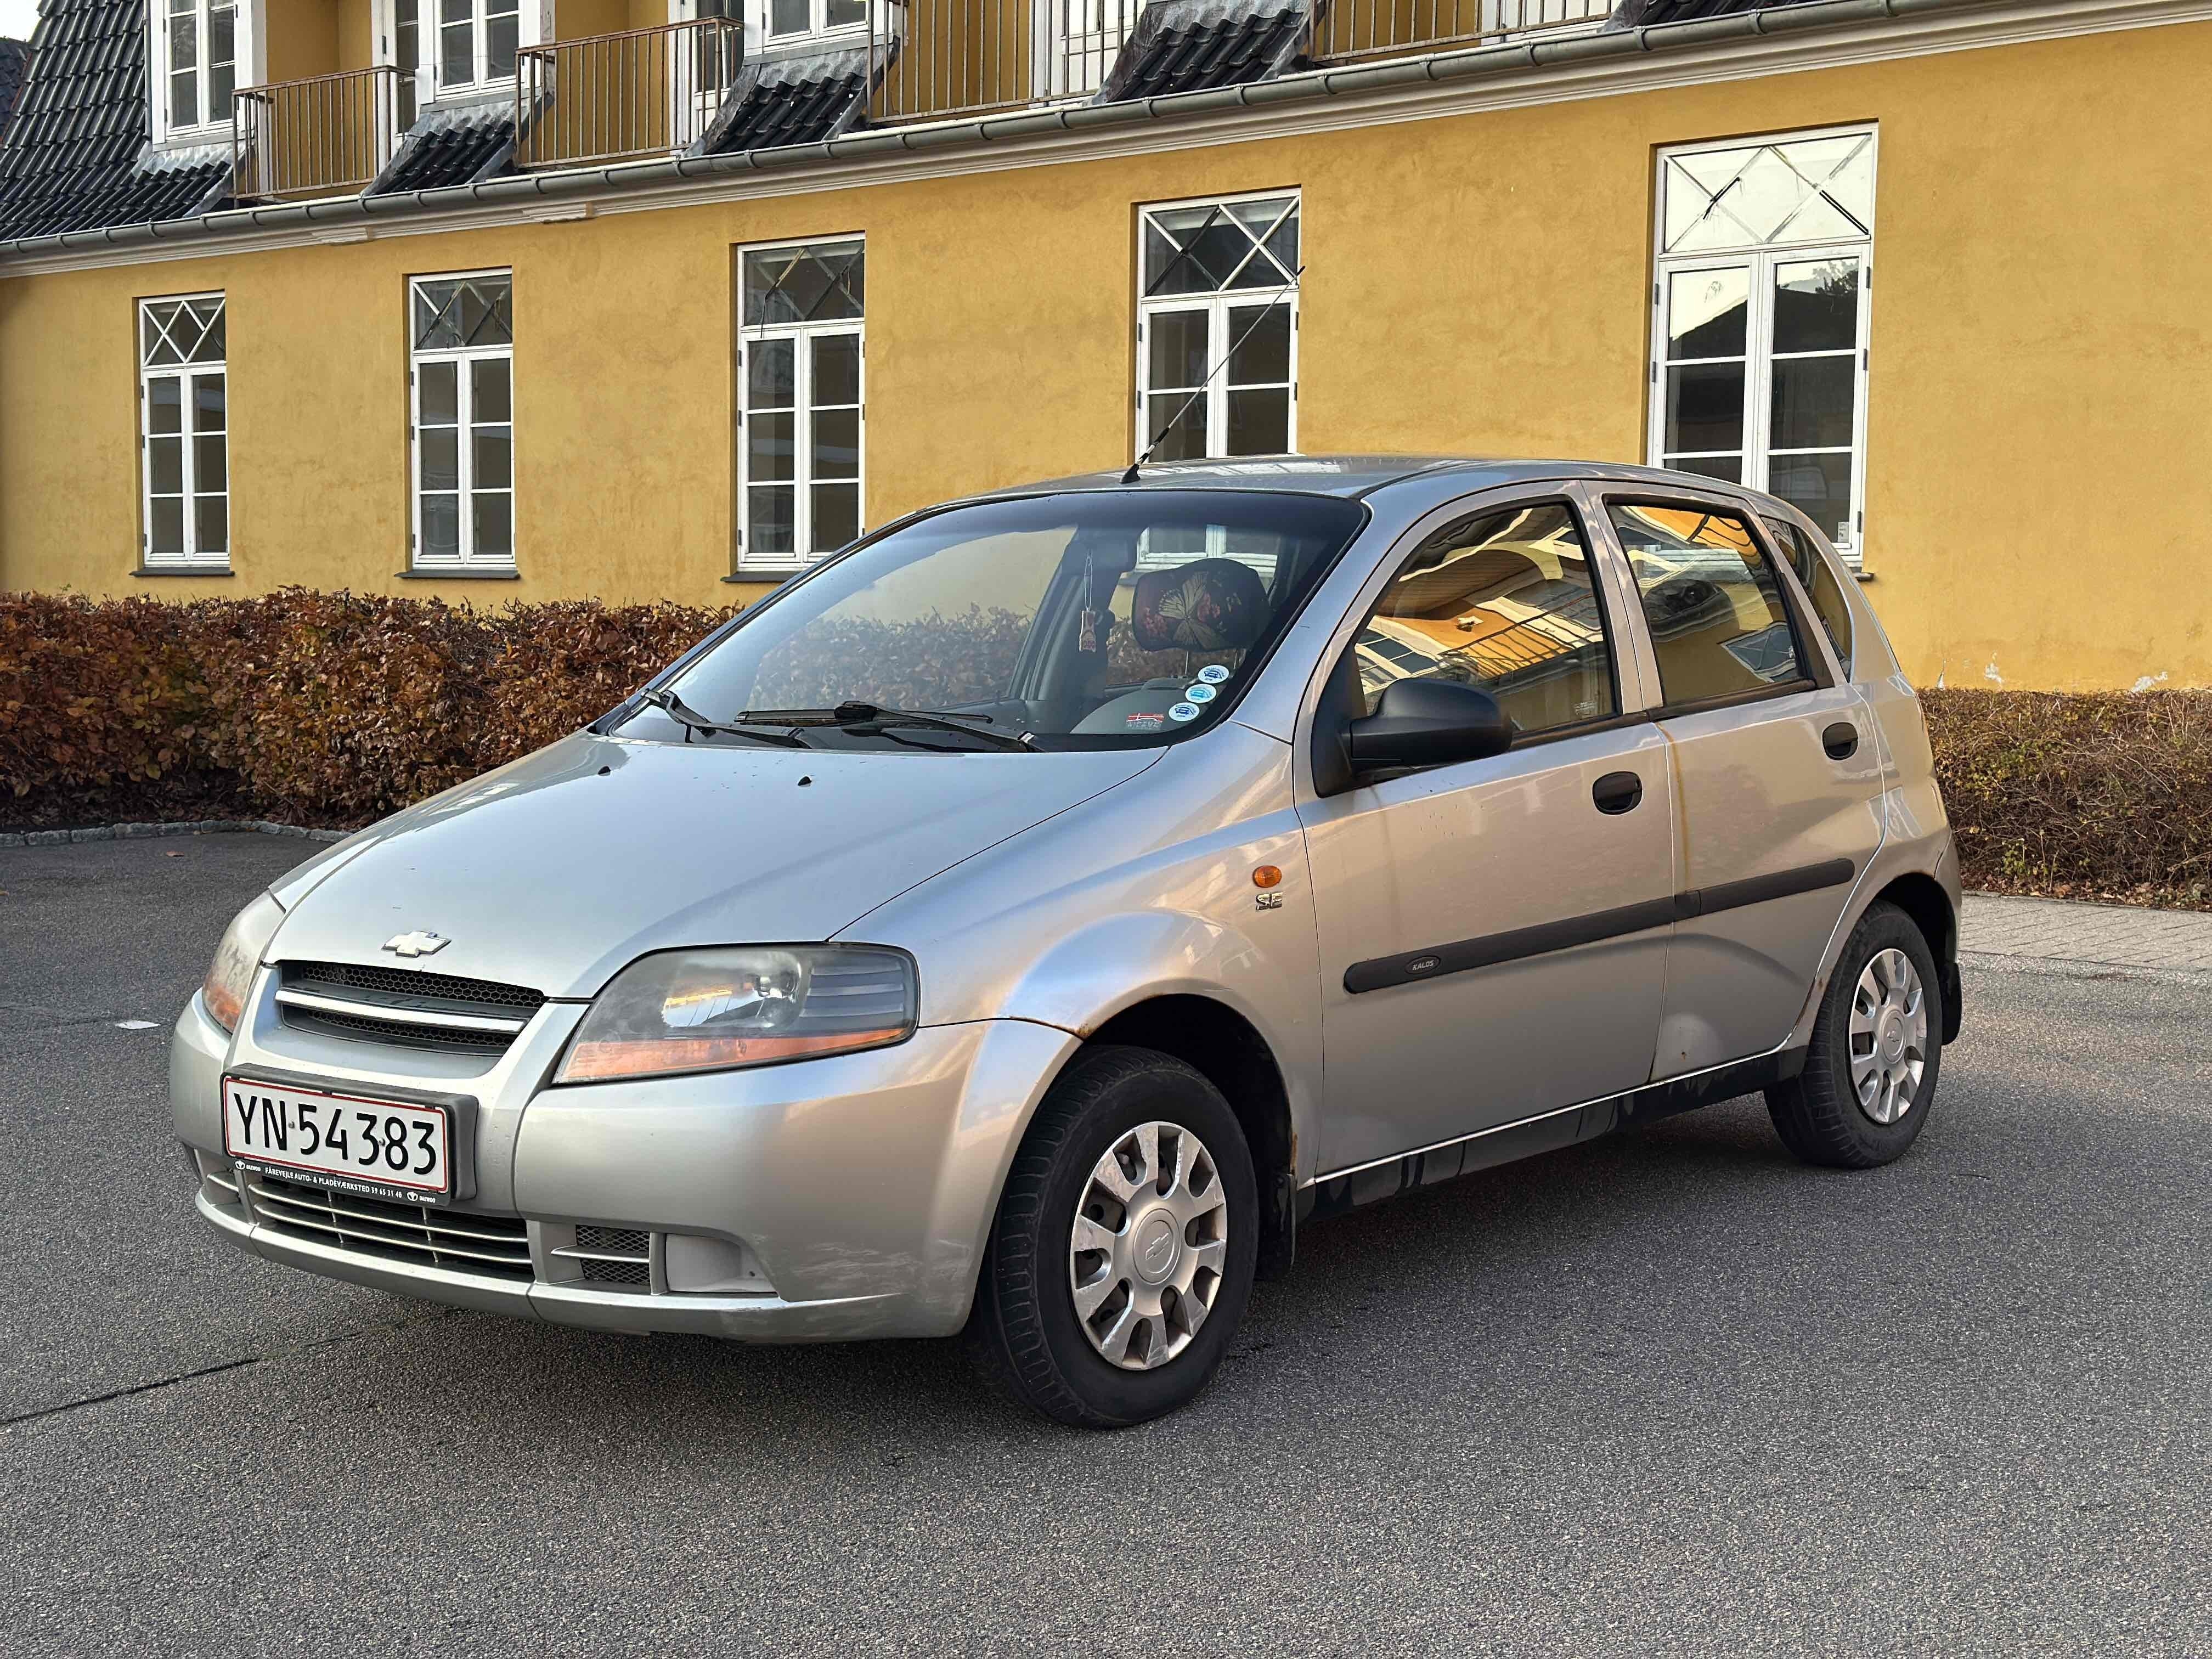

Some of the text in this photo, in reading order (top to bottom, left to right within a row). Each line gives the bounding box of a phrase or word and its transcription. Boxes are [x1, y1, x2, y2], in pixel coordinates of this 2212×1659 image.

[1256, 891, 1283, 911] SE
[1413, 960, 1435, 970] KALOS
[233, 1093, 436, 1175] YN 54383
[265, 1166, 294, 1179] FÅREVEJLE
[294, 1173, 312, 1182] AUTO-
[318, 1177, 370, 1193] PLADEVÆRKSTED
